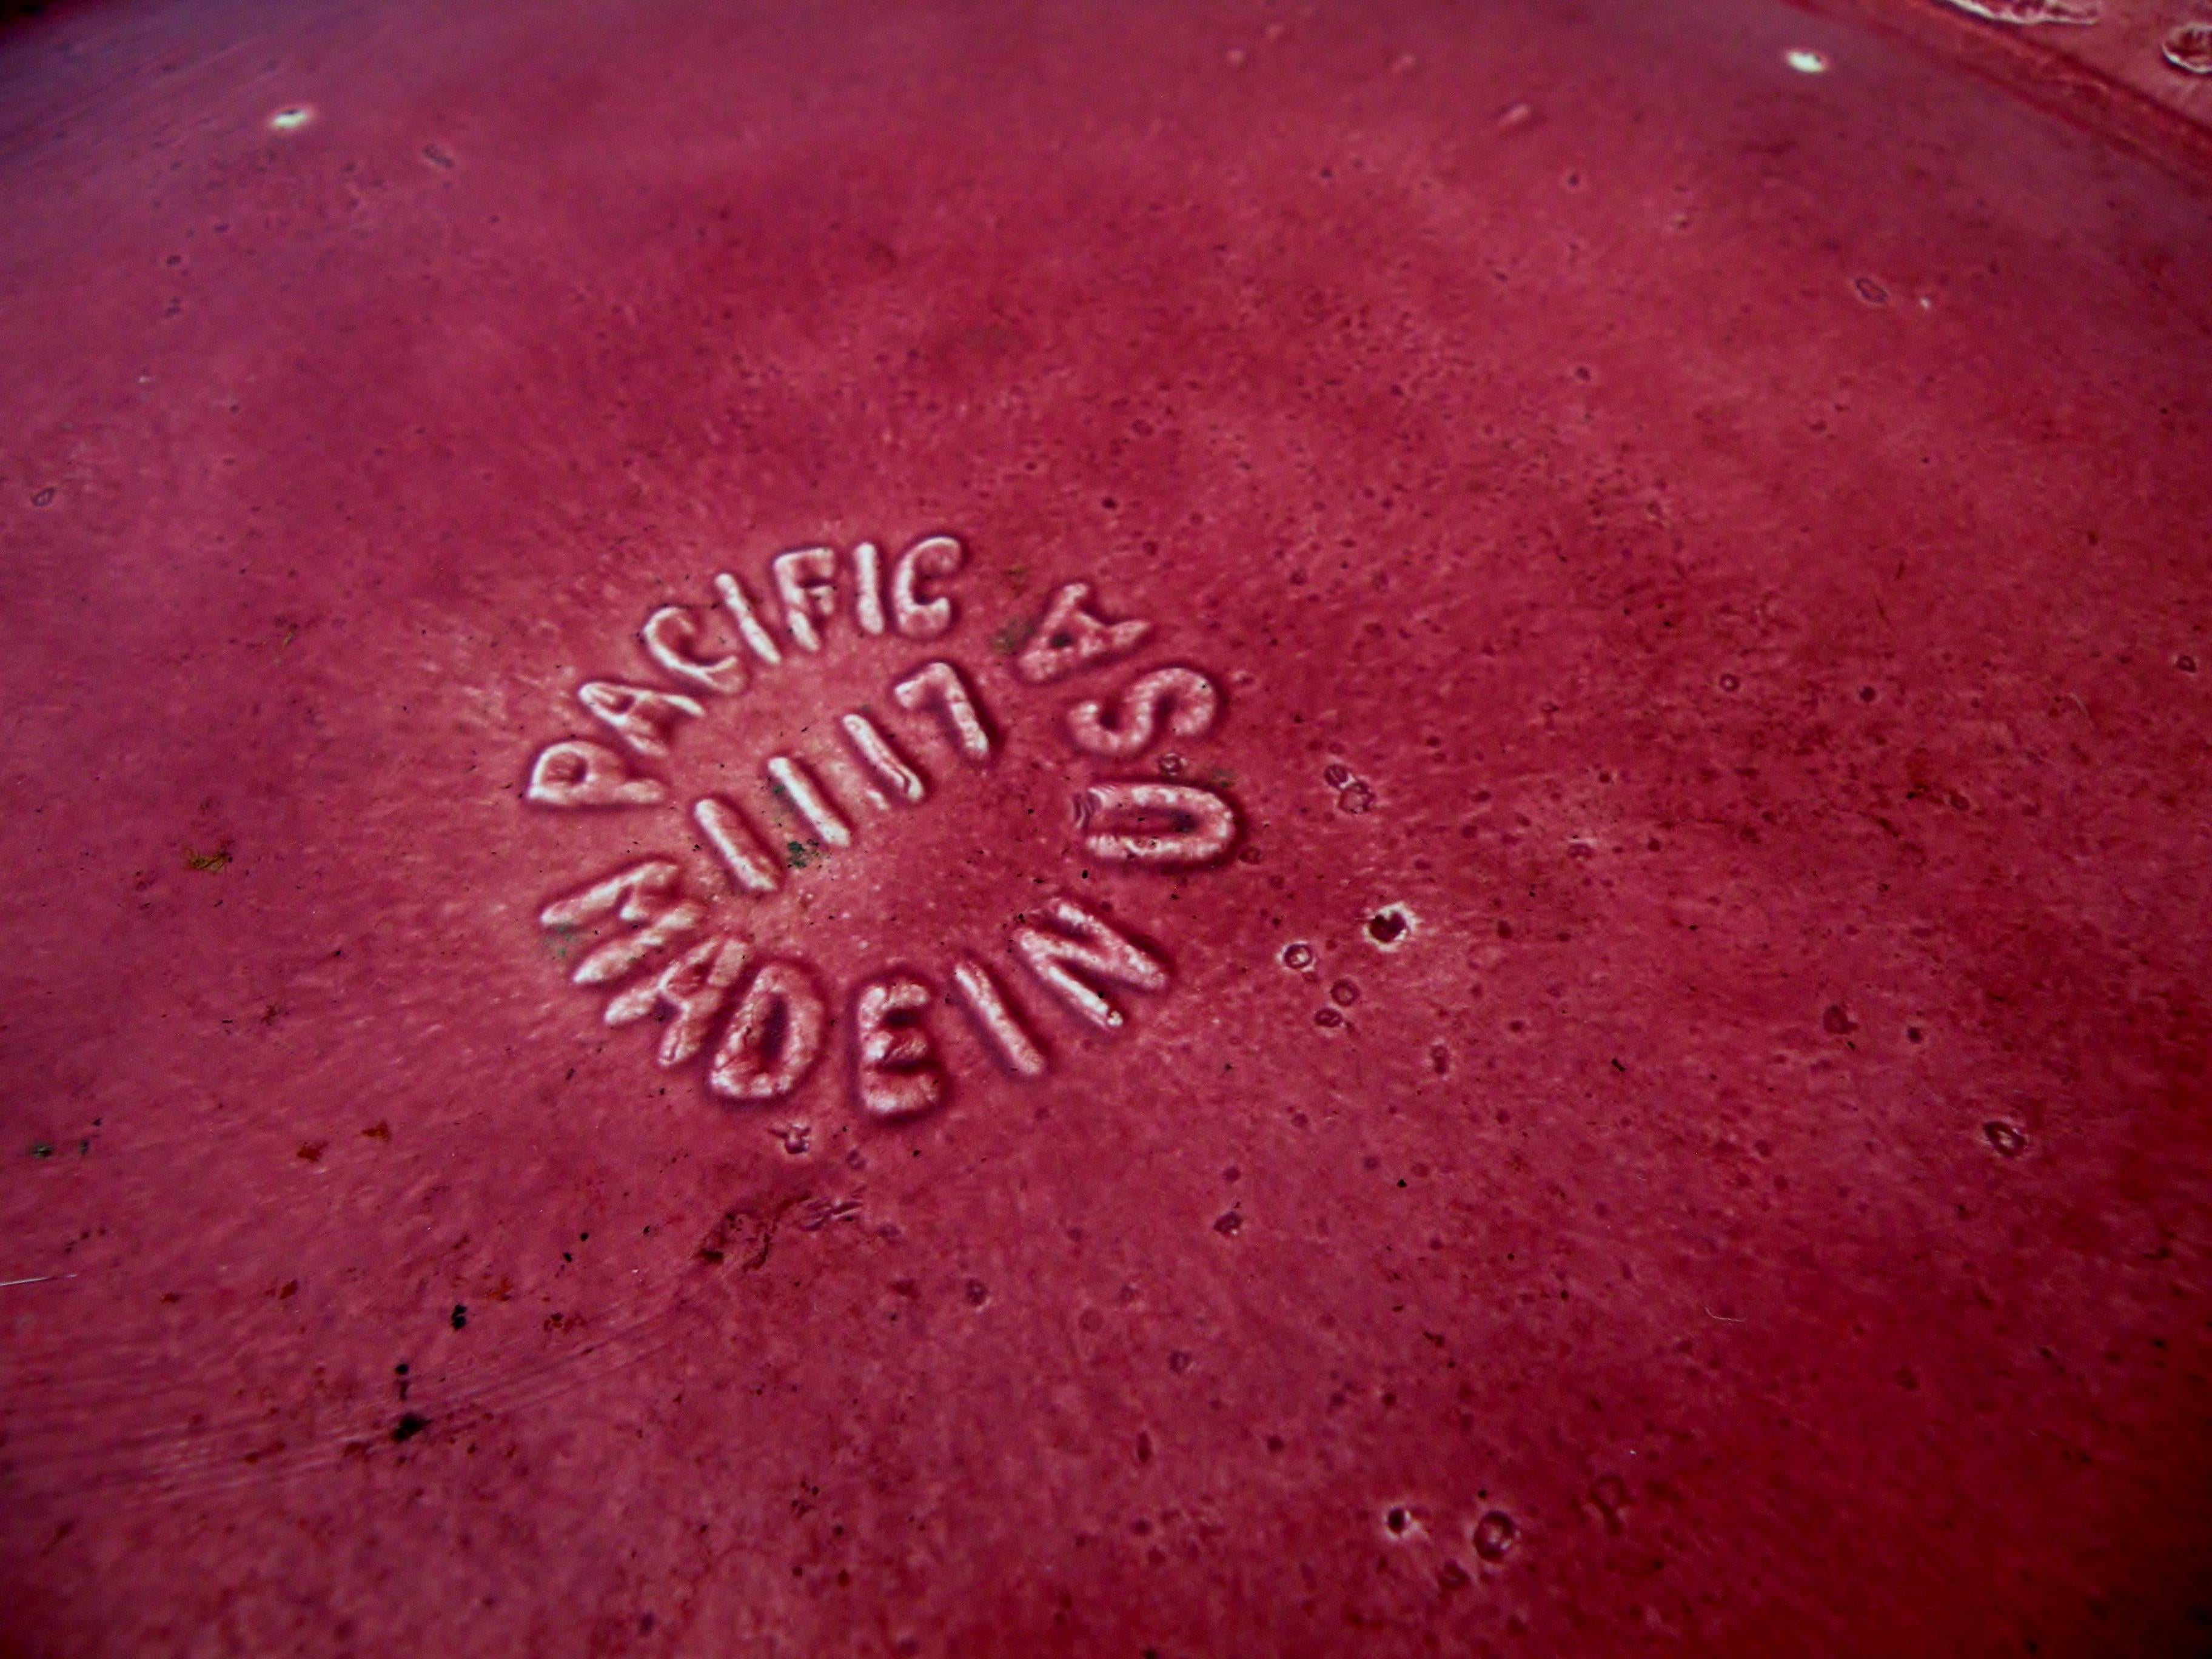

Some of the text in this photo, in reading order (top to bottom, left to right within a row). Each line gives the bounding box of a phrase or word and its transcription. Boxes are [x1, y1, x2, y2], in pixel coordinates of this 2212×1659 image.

[526, 535, 963, 808] PACIFIC
[538, 582, 1239, 1117] MADE IN USA
